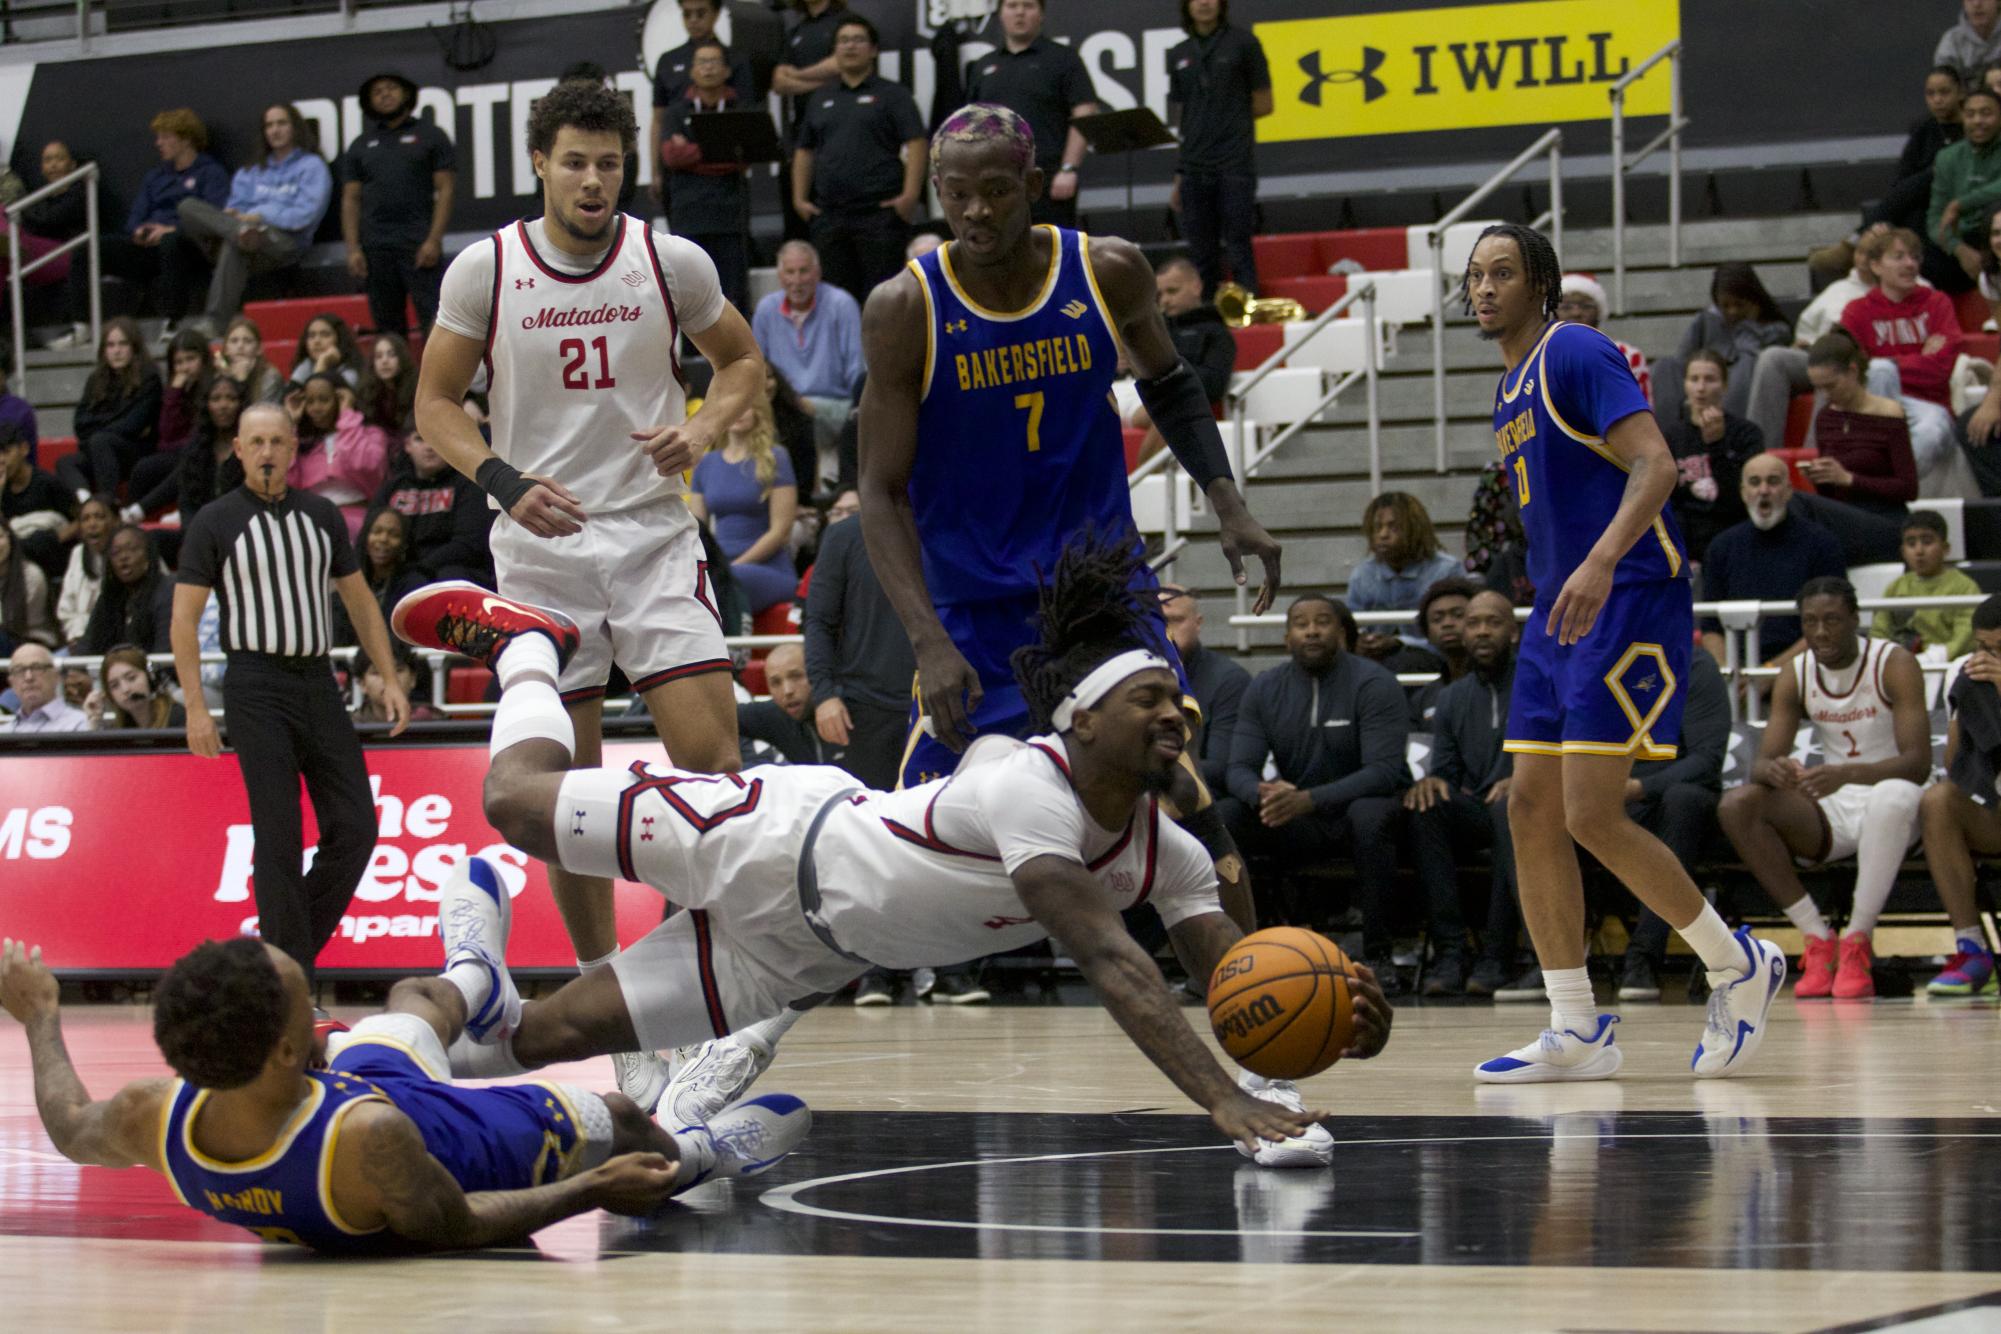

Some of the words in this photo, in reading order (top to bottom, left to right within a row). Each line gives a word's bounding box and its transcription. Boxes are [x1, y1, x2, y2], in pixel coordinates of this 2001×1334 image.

[1412, 45, 1438, 95] I
[1448, 32, 1643, 92] WILL
[521, 303, 643, 330] Matadors
[559, 335, 616, 390] 21
[955, 334, 1092, 391] BAKERSFIELD
[1014, 391, 1045, 452] 7
[1842, 730, 1862, 758] 1
